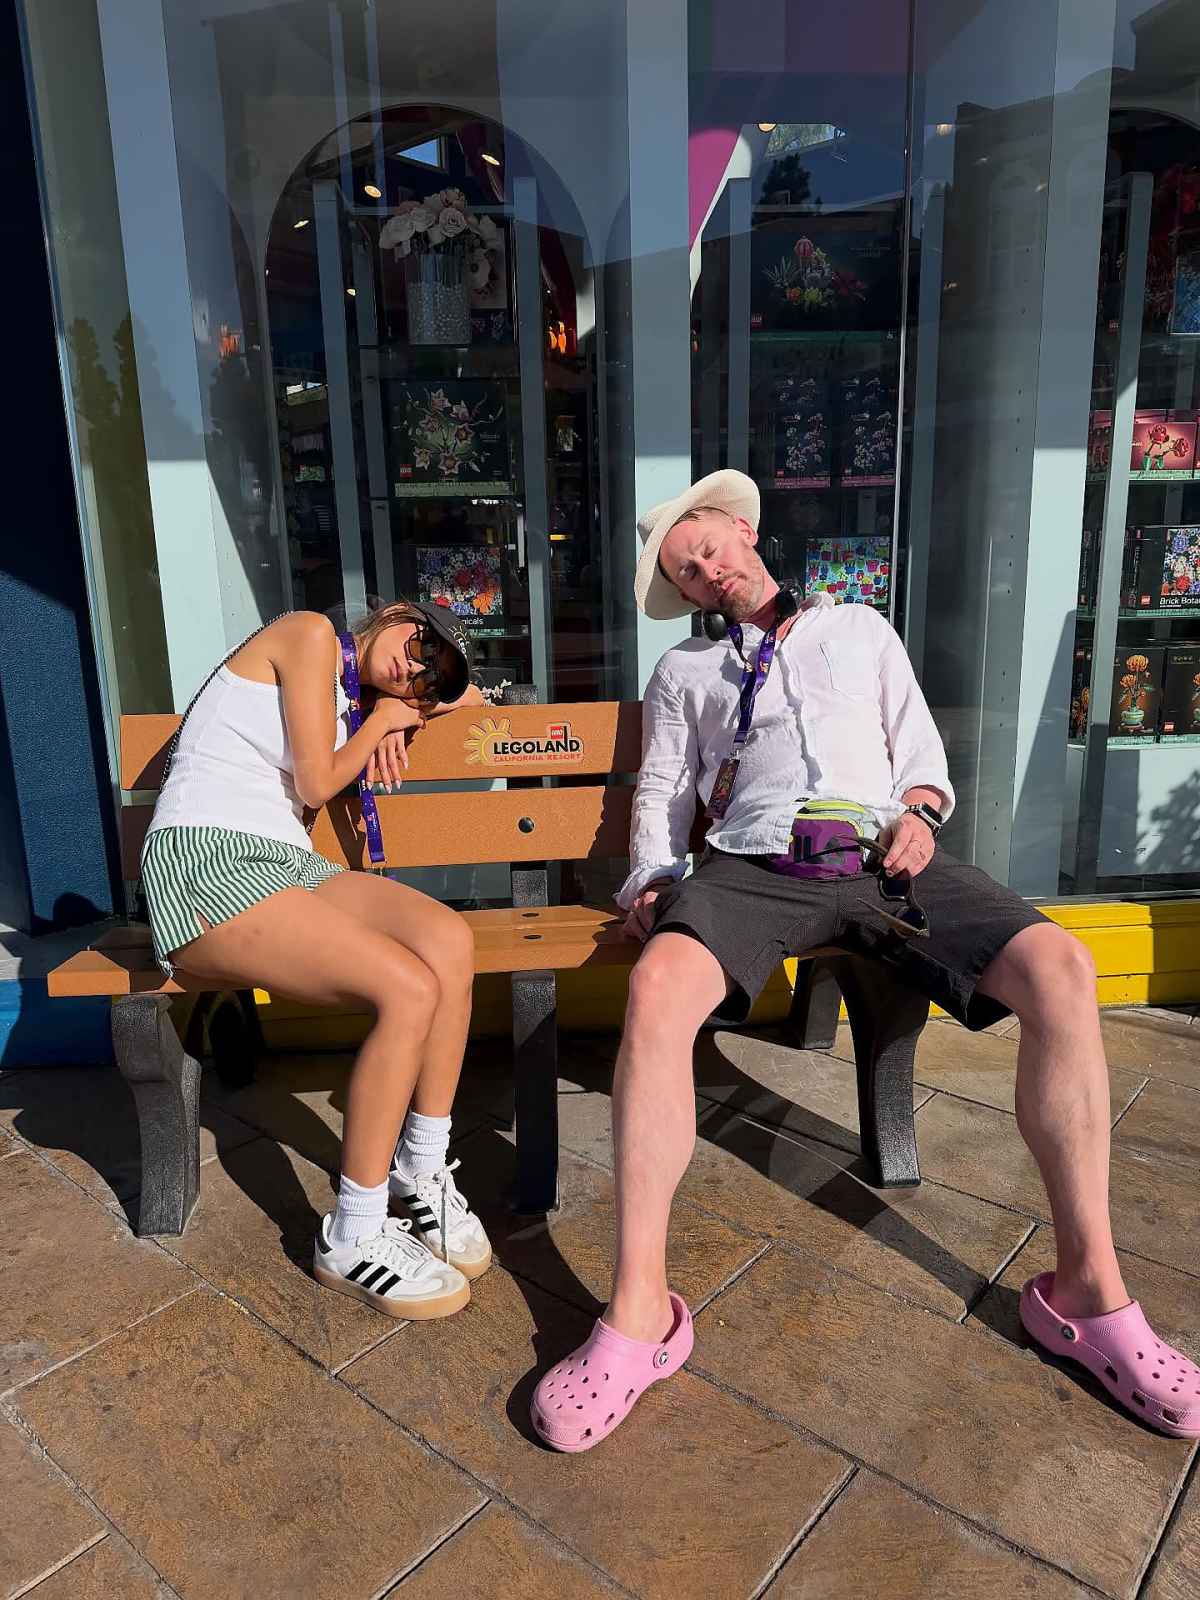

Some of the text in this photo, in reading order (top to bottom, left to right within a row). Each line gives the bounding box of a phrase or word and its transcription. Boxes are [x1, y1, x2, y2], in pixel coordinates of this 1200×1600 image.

[493, 728, 581, 755] LEGOLAND
[493, 753, 581, 763] CALIFORNIA RESORT
